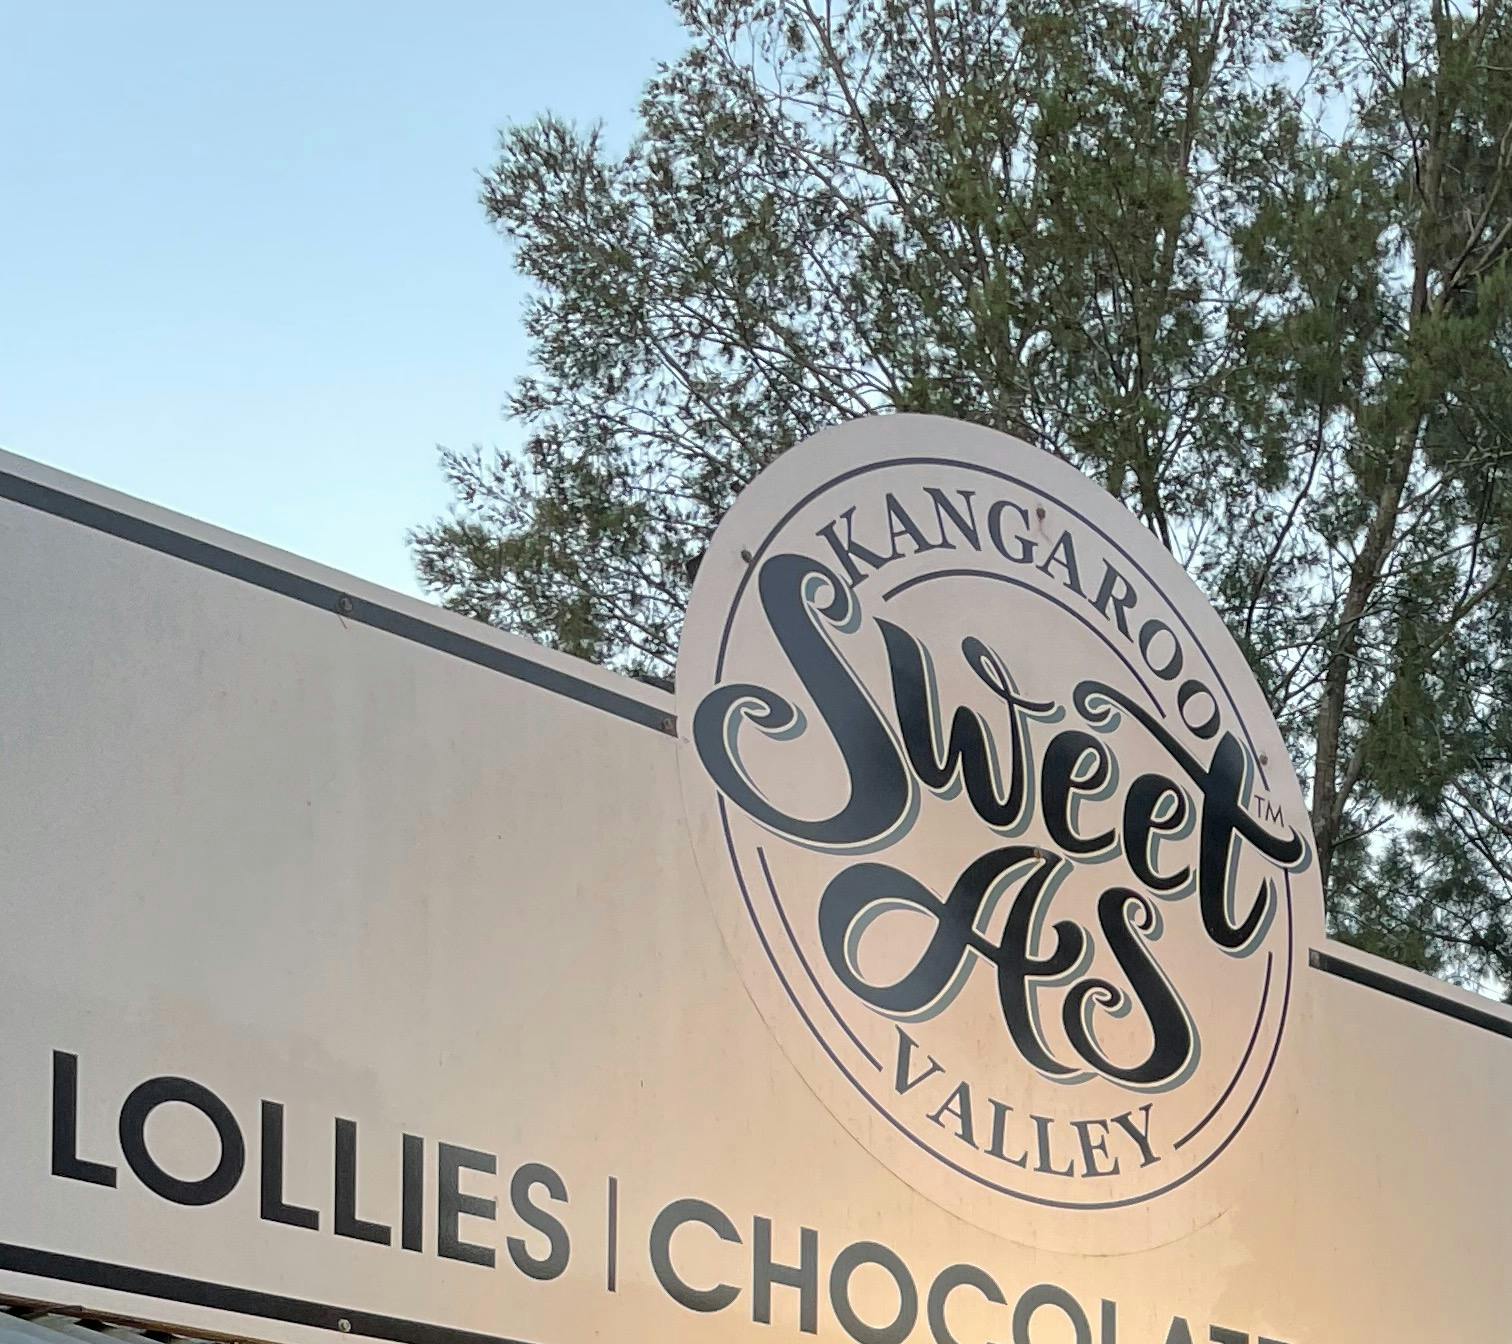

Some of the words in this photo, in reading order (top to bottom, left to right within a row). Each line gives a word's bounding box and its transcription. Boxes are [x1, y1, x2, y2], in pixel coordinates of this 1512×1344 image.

[815, 486, 1221, 739] KANGAROO
[694, 553, 1308, 953] Sweet
[50, 1049, 571, 1281] LOLLIES
[892, 1024, 1160, 1179] VALLEY
